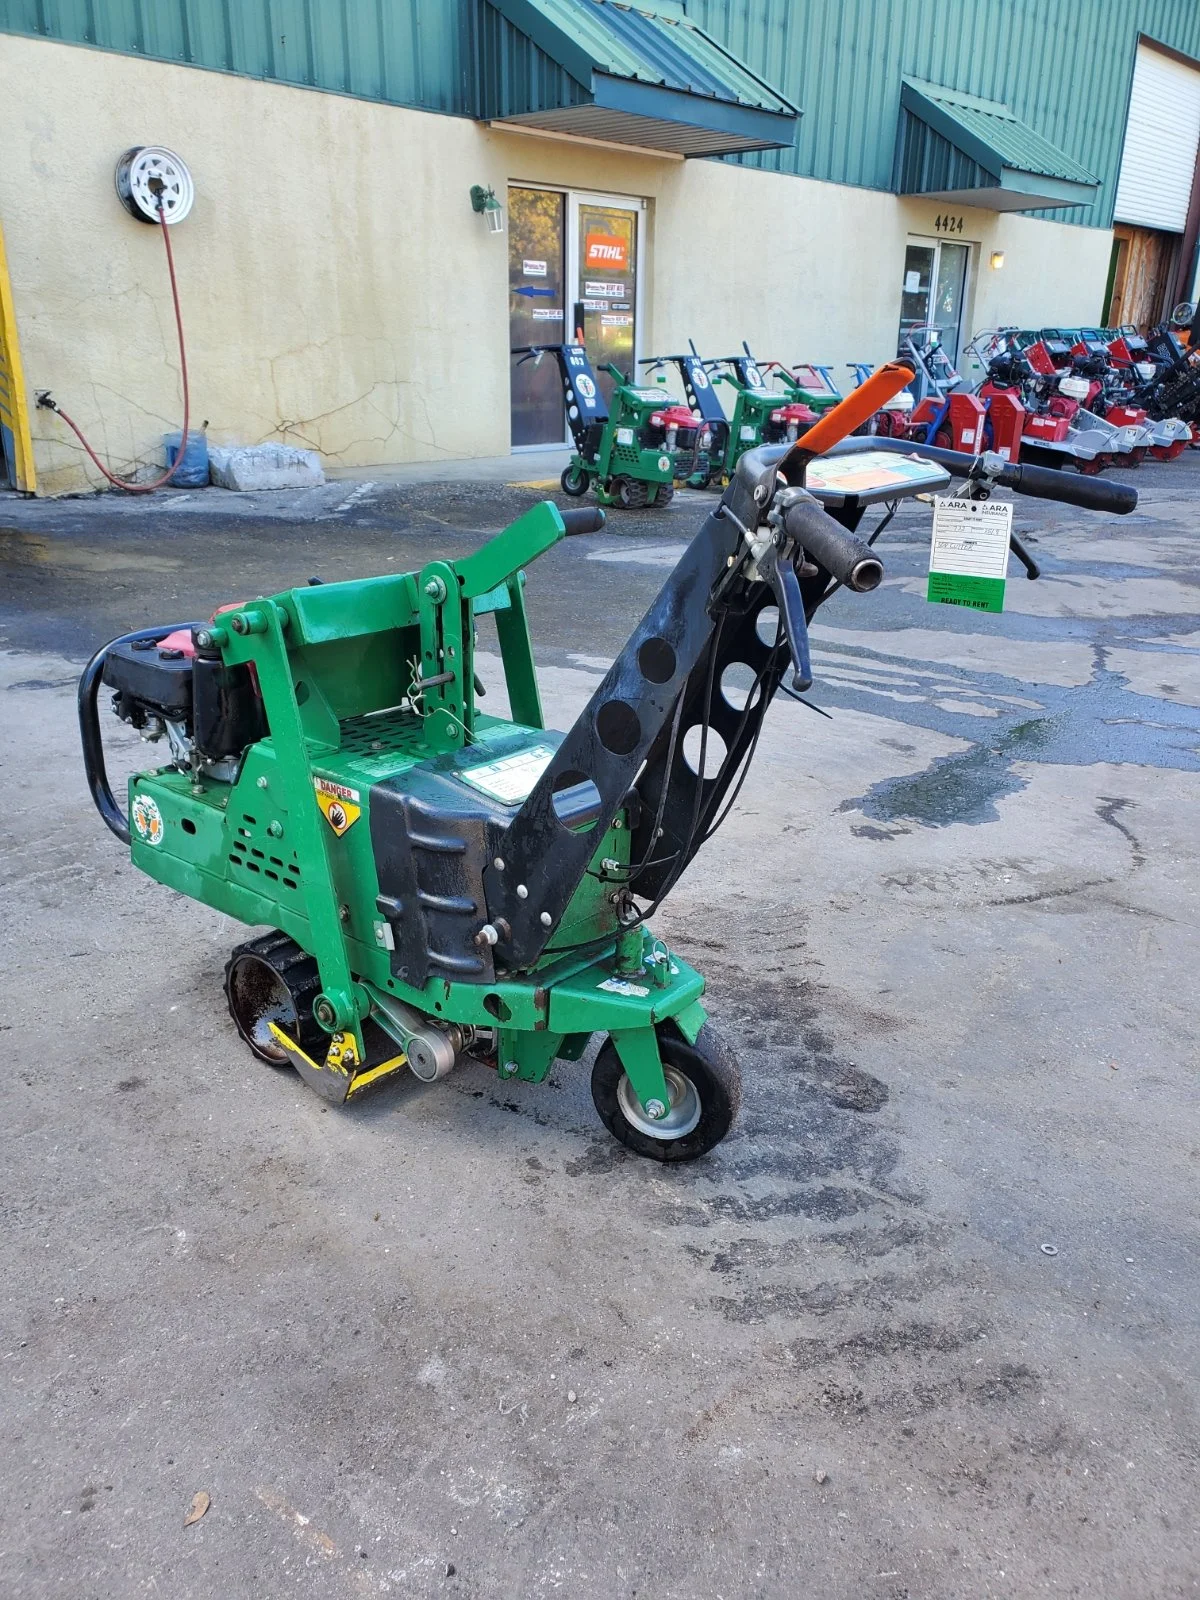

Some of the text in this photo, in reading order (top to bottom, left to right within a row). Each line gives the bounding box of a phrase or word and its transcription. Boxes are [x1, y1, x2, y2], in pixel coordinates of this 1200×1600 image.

[935, 214, 963, 233] 4424
[589, 244, 623, 260] STIHL
[947, 501, 967, 509] ARA
[941, 597, 961, 605] READY
[972, 601, 989, 609] RENT
[321, 780, 352, 798] DANGER
